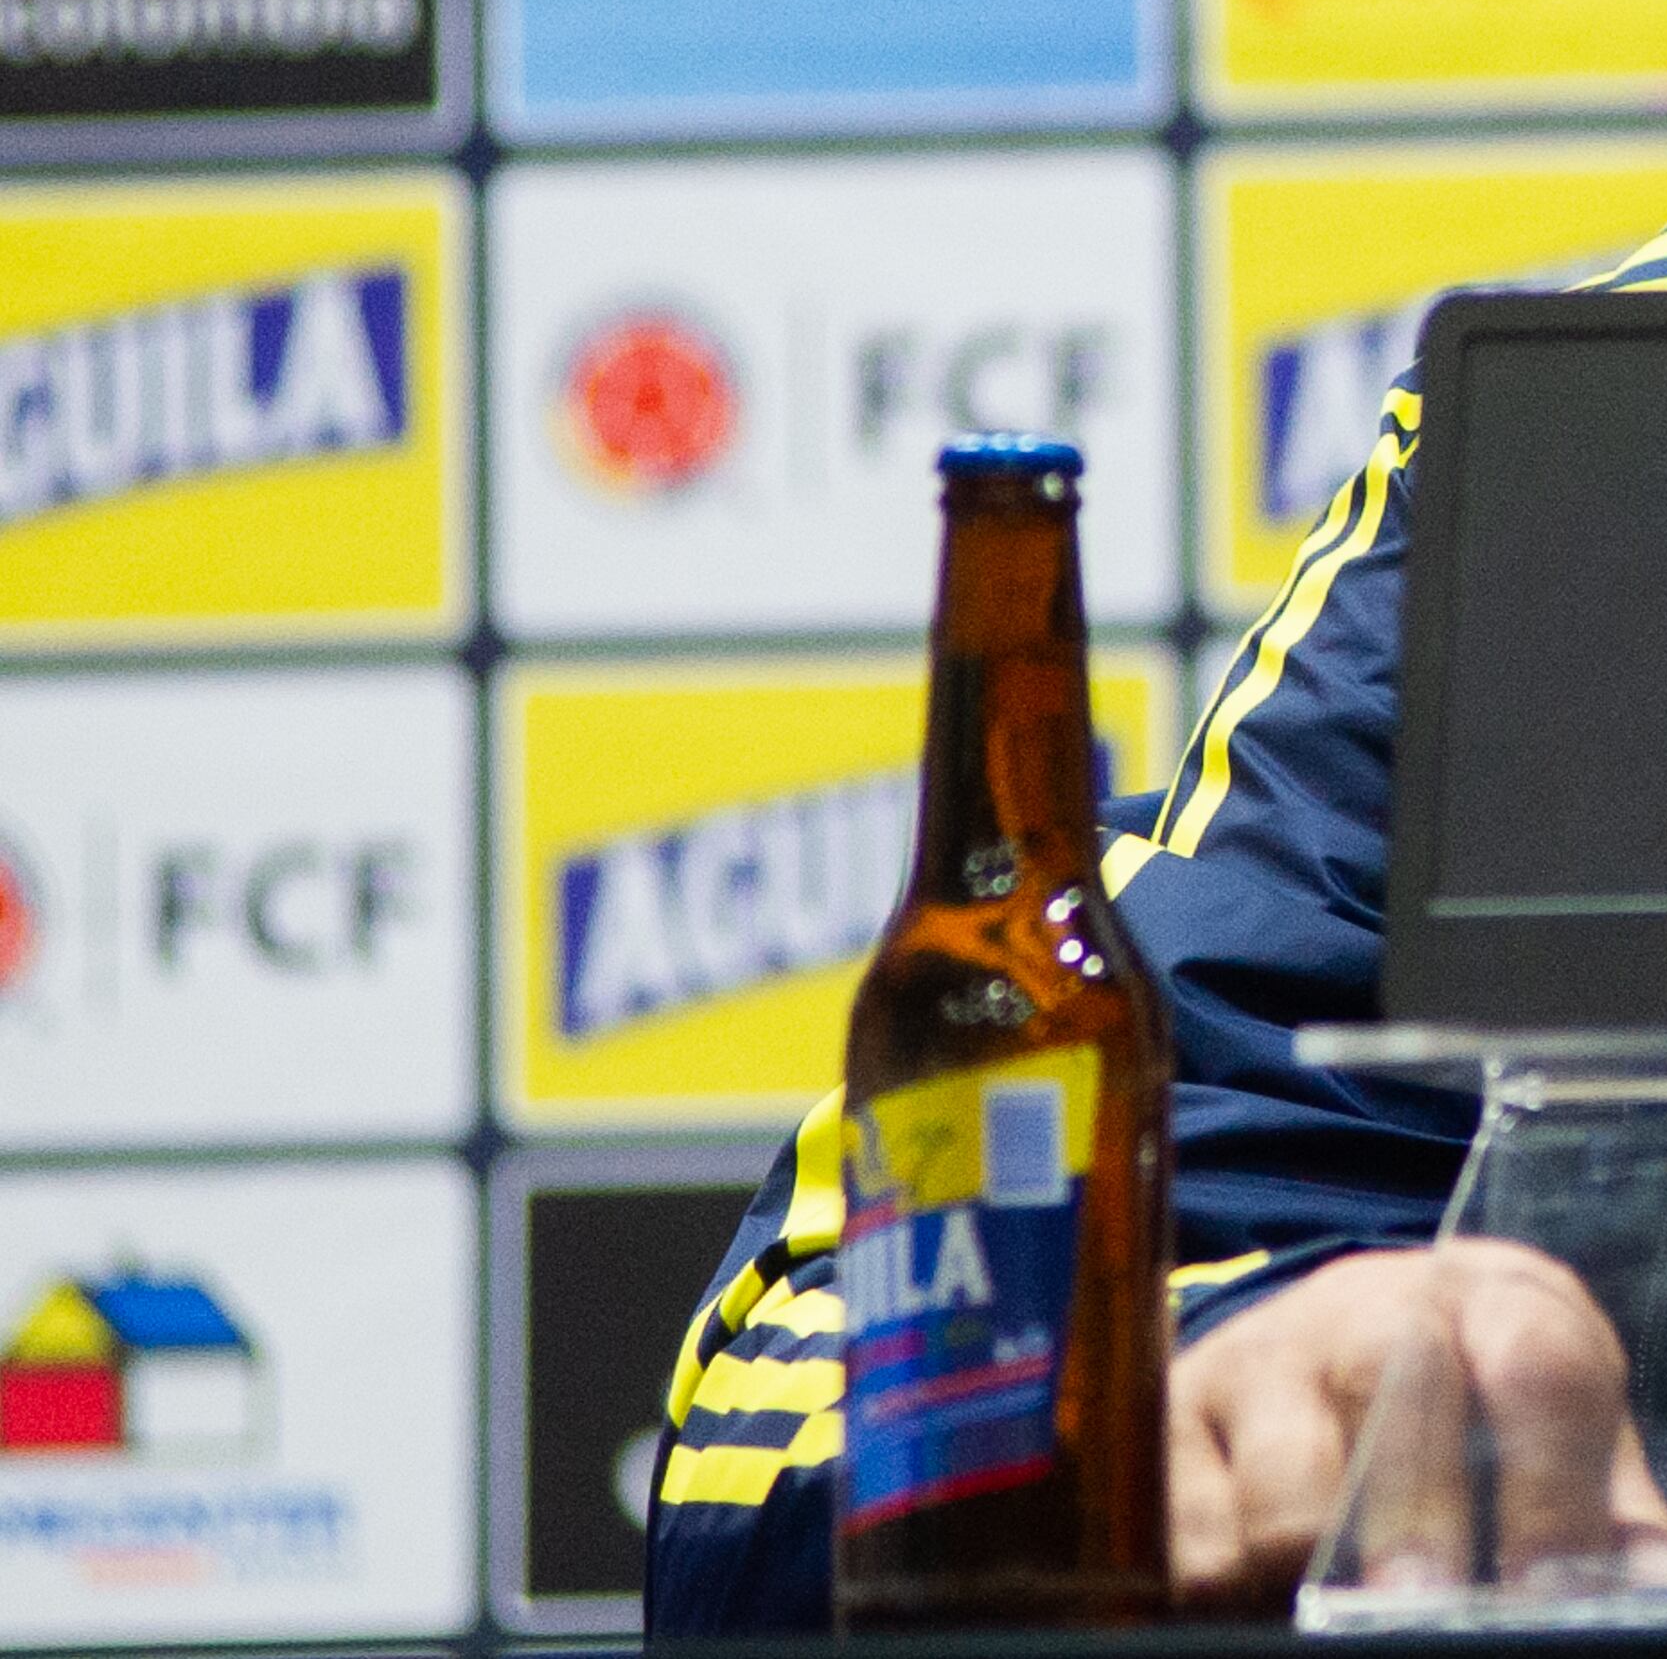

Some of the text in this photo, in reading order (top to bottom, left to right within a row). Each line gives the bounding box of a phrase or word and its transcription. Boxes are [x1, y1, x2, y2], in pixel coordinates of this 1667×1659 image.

[0, 272, 398, 520] GUILA
[858, 318, 1122, 450] FCF
[152, 840, 415, 972] FCF
